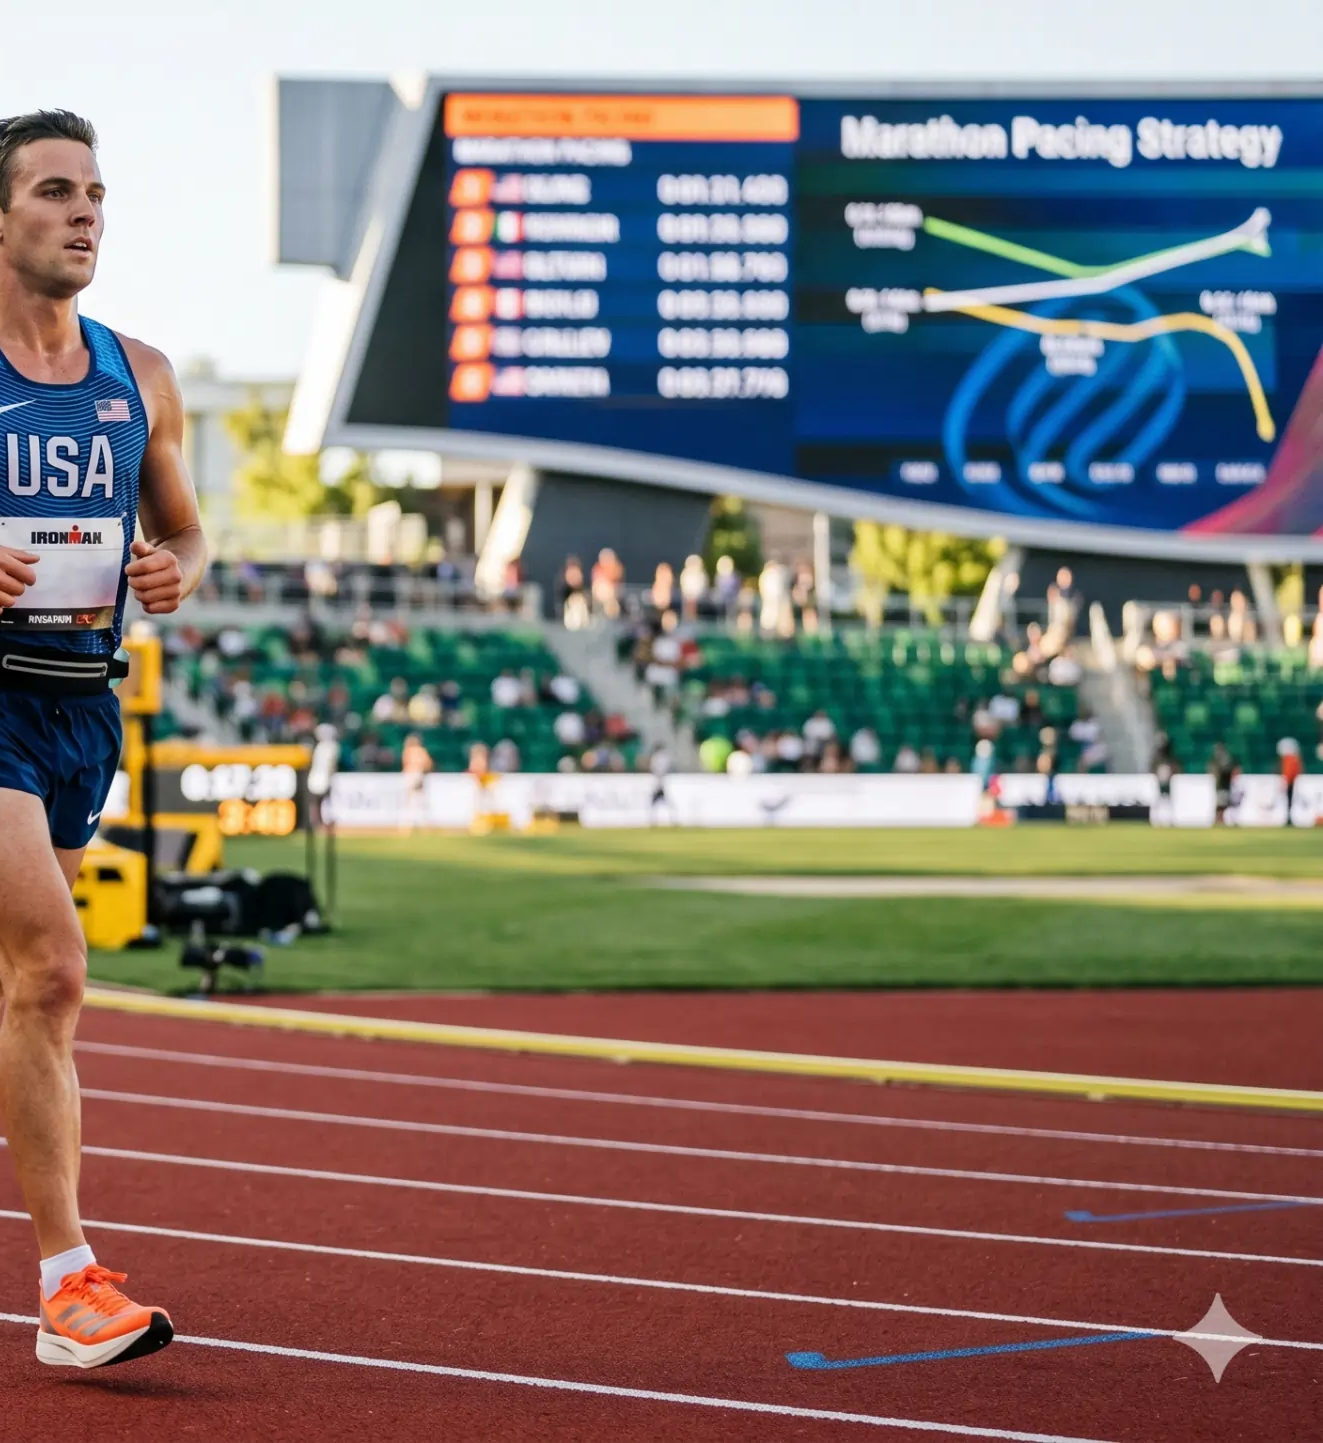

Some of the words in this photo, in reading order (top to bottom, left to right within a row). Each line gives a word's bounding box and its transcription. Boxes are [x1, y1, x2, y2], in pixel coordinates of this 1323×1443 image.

[841, 115, 1008, 159] Marathon
[1011, 116, 1132, 168] Pacing
[1137, 117, 1283, 168] Strategy
[7, 433, 114, 498] USA
[31, 526, 103, 545] IRONMAN
